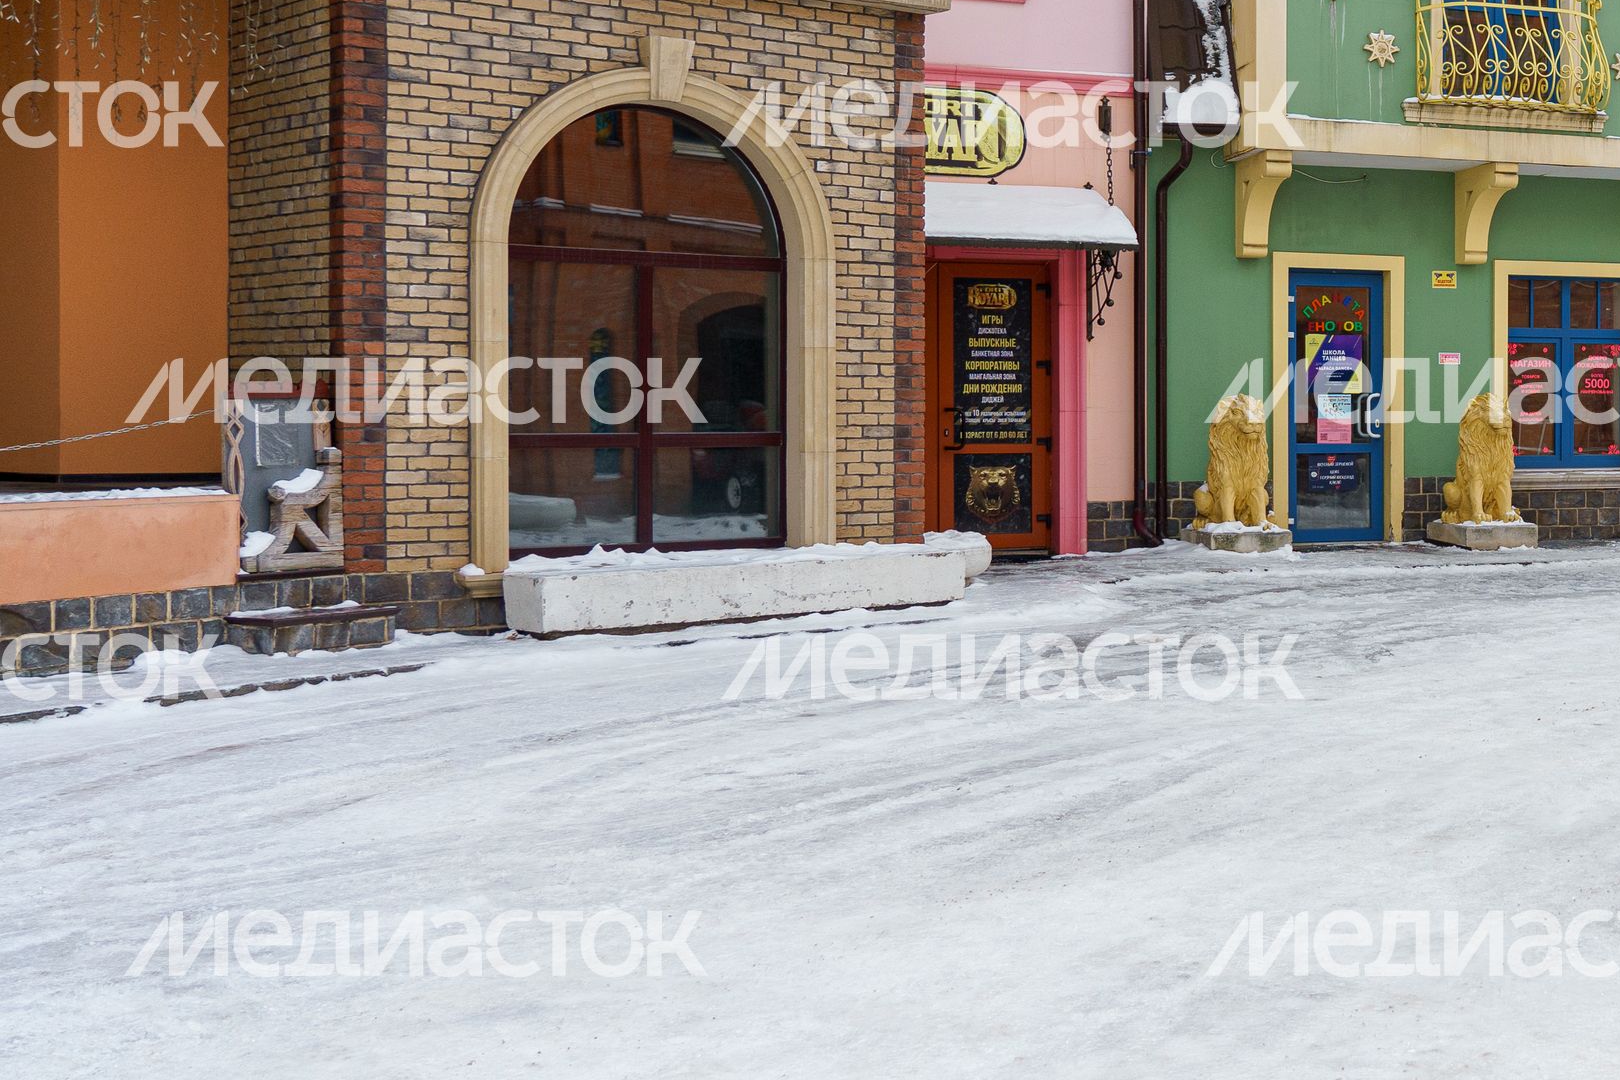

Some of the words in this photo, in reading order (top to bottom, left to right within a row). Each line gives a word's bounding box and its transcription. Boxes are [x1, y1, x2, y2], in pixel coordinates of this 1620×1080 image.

[924, 99, 976, 117] ORT
[1302, 294, 1365, 321] ПЛАНЕТА
[982, 315, 1003, 324] ИГРЫ
[1307, 321, 1363, 332] ЕНОТОВ
[968, 338, 1016, 347] ВЫПУСКНЫЕ
[965, 361, 1020, 370] КОРПОРАТИВЫ
[1584, 378, 1610, 388] 5000
[963, 384, 979, 394] ДНИ
[981, 384, 1022, 394] РОЖДЕНИЯ
